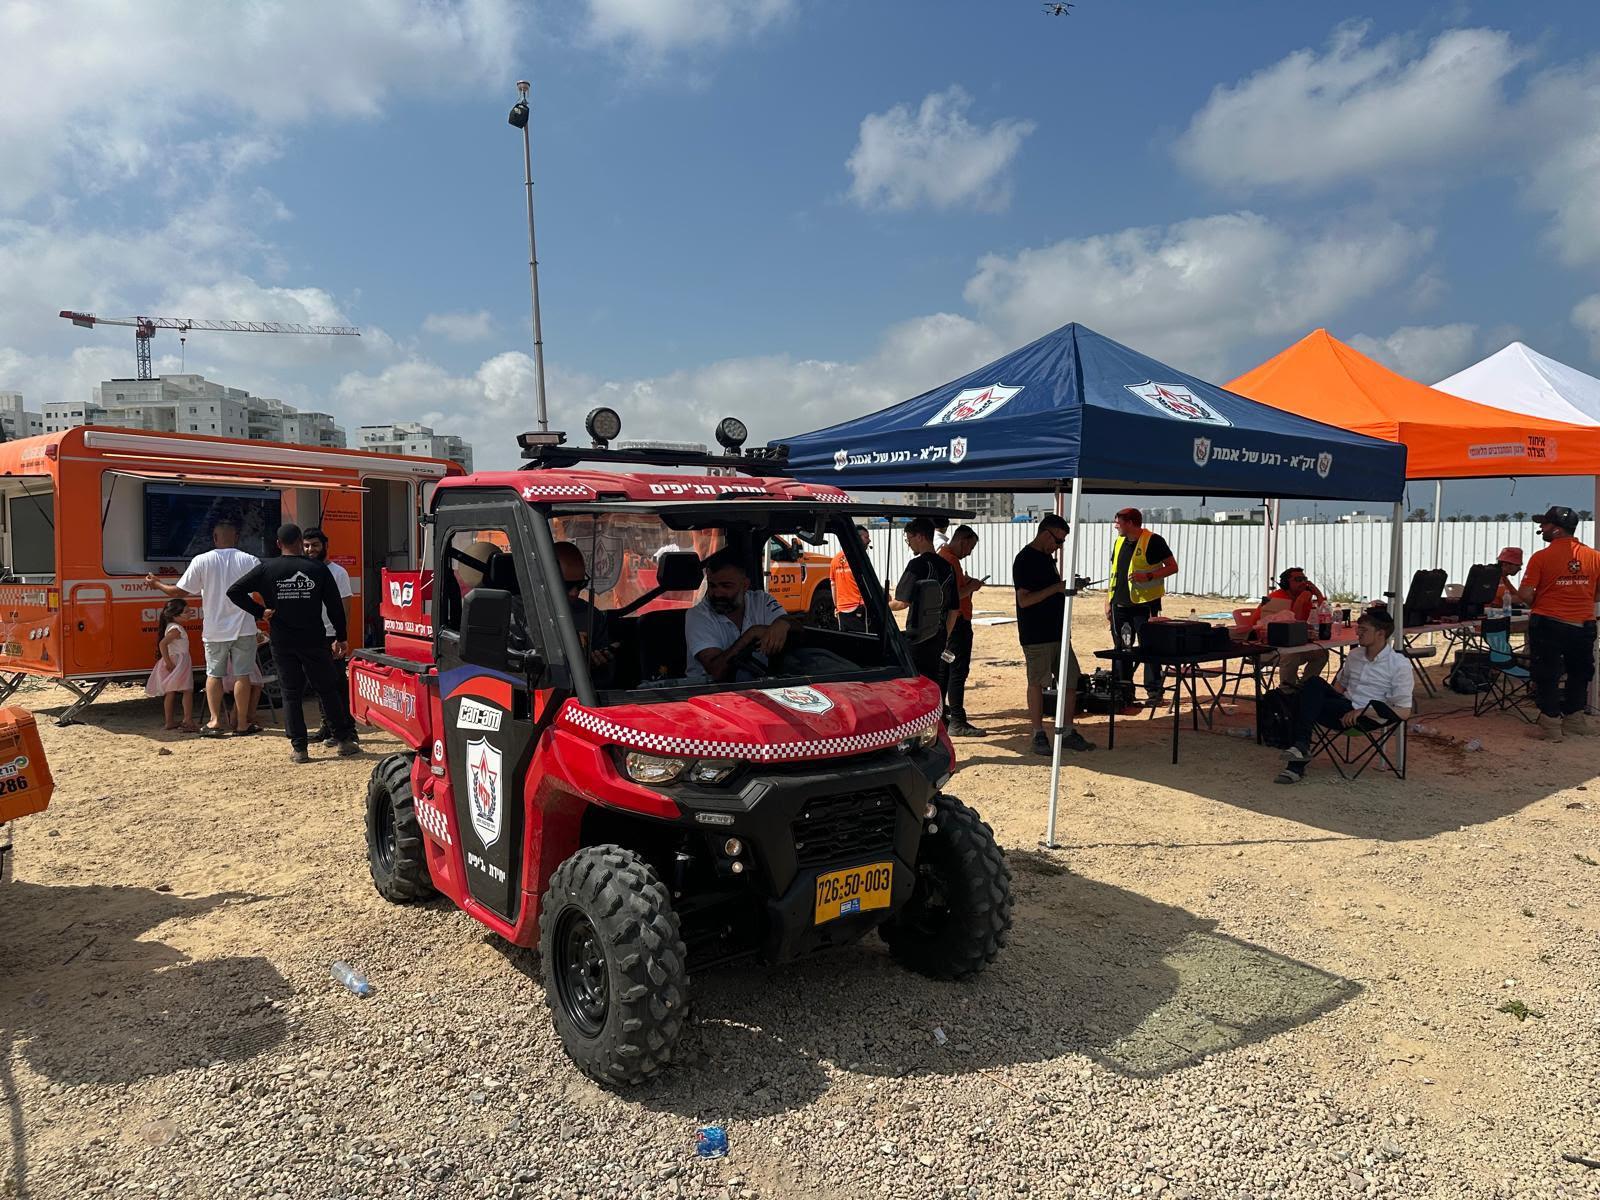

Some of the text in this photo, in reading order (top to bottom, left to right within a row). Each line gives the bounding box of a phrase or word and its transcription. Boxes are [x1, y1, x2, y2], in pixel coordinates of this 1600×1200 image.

[1528, 436, 1546, 447] איחוד
[873, 451, 889, 463] של
[890, 450, 911, 462] רגע
[920, 446, 947, 461] זק"א
[1212, 447, 1240, 461] אמת
[1242, 448, 1259, 463] של
[1261, 452, 1281, 465] רגע
[1527, 447, 1546, 458] הצלה
[849, 454, 871, 465] אמת
[649, 483, 717, 494] הג'יפים
[120, 581, 155, 592] לאומי
[459, 704, 500, 730] can-am
